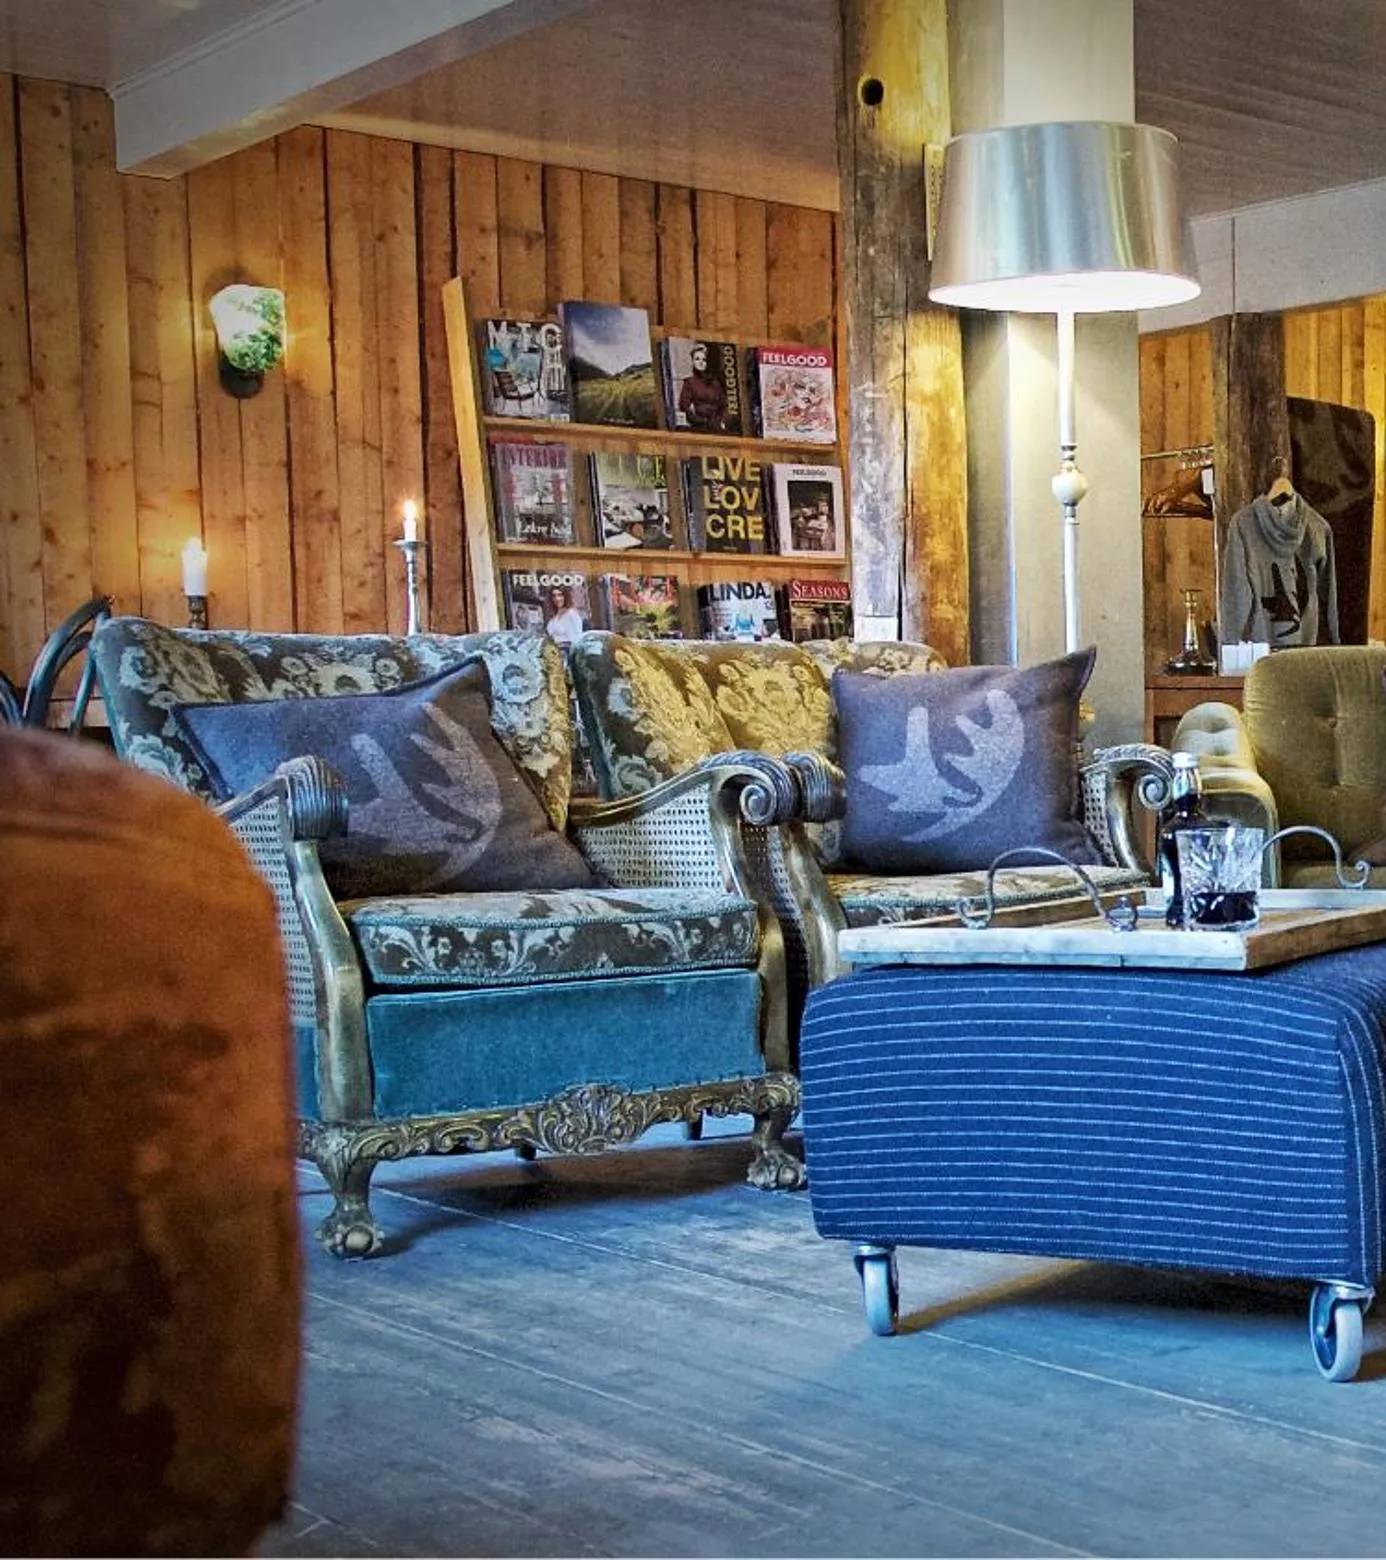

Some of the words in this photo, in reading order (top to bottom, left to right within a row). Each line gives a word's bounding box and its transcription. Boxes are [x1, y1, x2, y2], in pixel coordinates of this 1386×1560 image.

[762, 351, 827, 367] FEELGOOD
[724, 345, 739, 415] FEELGOOD
[702, 455, 761, 481] LIVE
[703, 485, 761, 511] LOV
[705, 513, 764, 541] CRE
[512, 573, 584, 587] FEELGOOD
[792, 580, 848, 598] SEASONS
